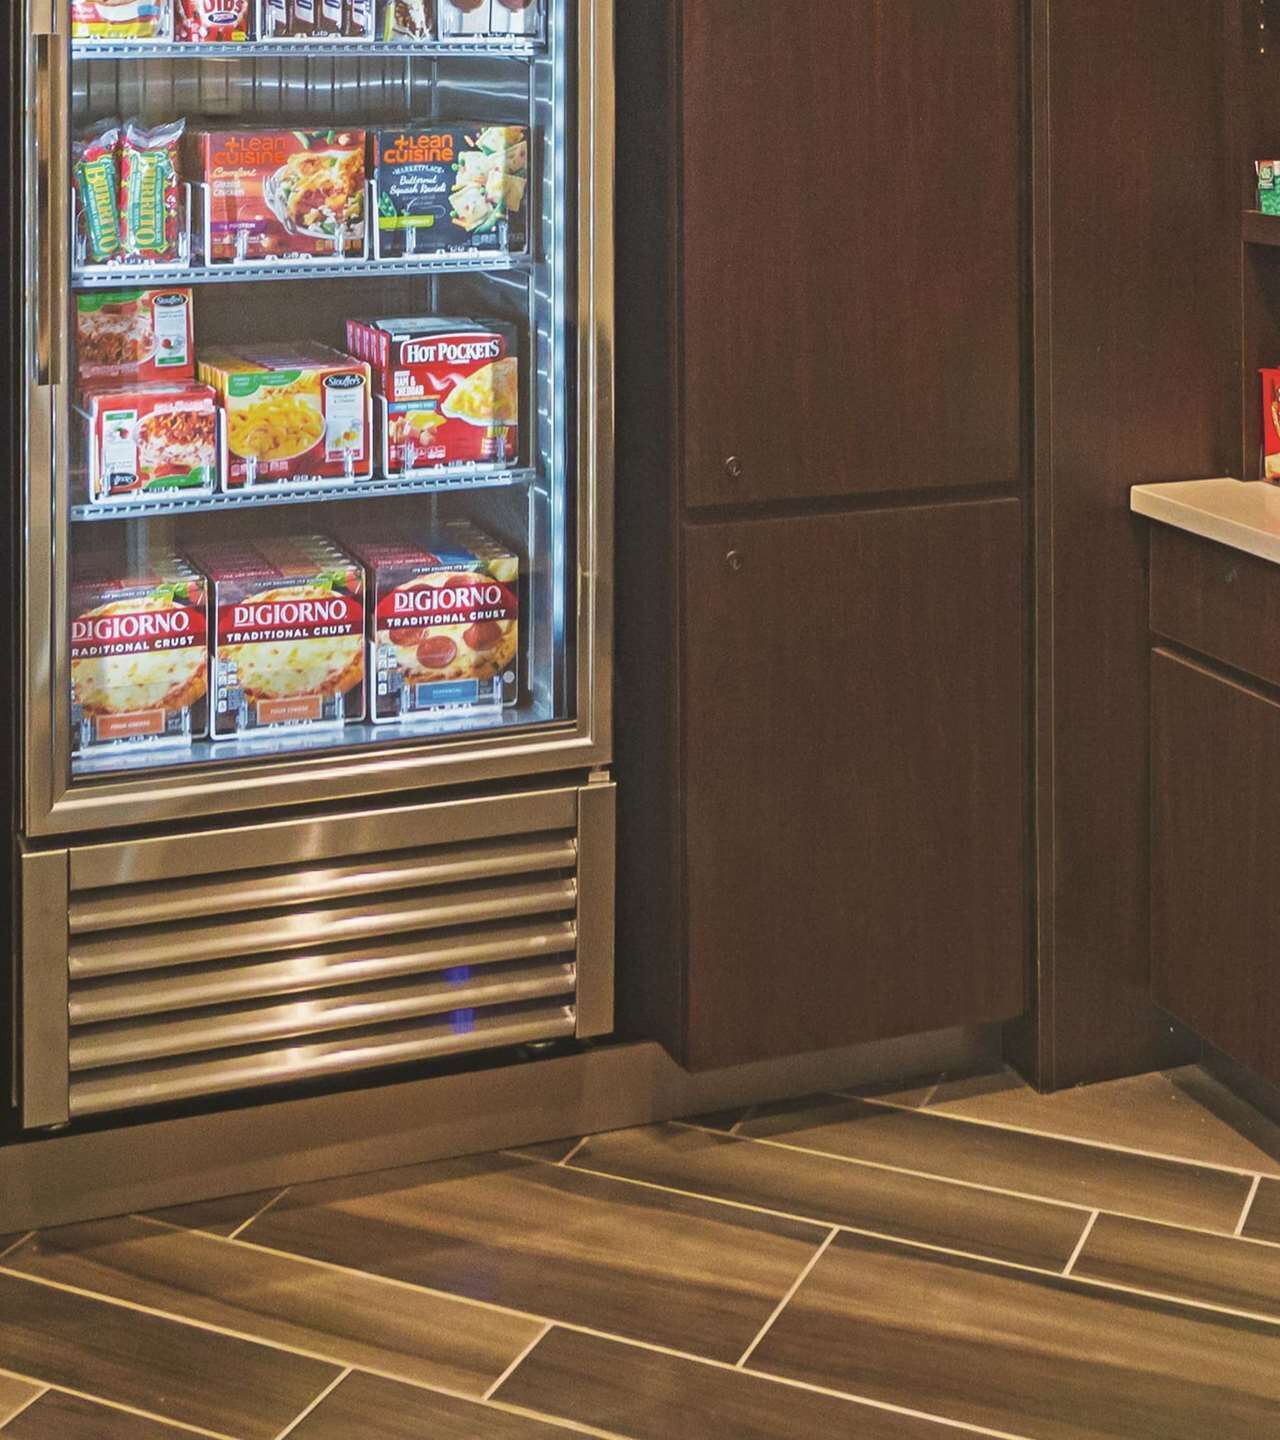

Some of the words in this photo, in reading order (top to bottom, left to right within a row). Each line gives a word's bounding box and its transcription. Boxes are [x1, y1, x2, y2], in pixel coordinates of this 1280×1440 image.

[408, 134, 453, 149] Lean
[214, 151, 286, 165] cuisine
[383, 148, 453, 163] cuisine
[406, 345, 435, 363] HOT
[438, 341, 500, 361] POCKETS
[387, 612, 466, 627] TRADITIONAL
[469, 609, 507, 621] CRUST
[227, 629, 309, 643] TRADITIONAL
[314, 624, 350, 637] CRUST
[155, 635, 194, 649] CRUST
